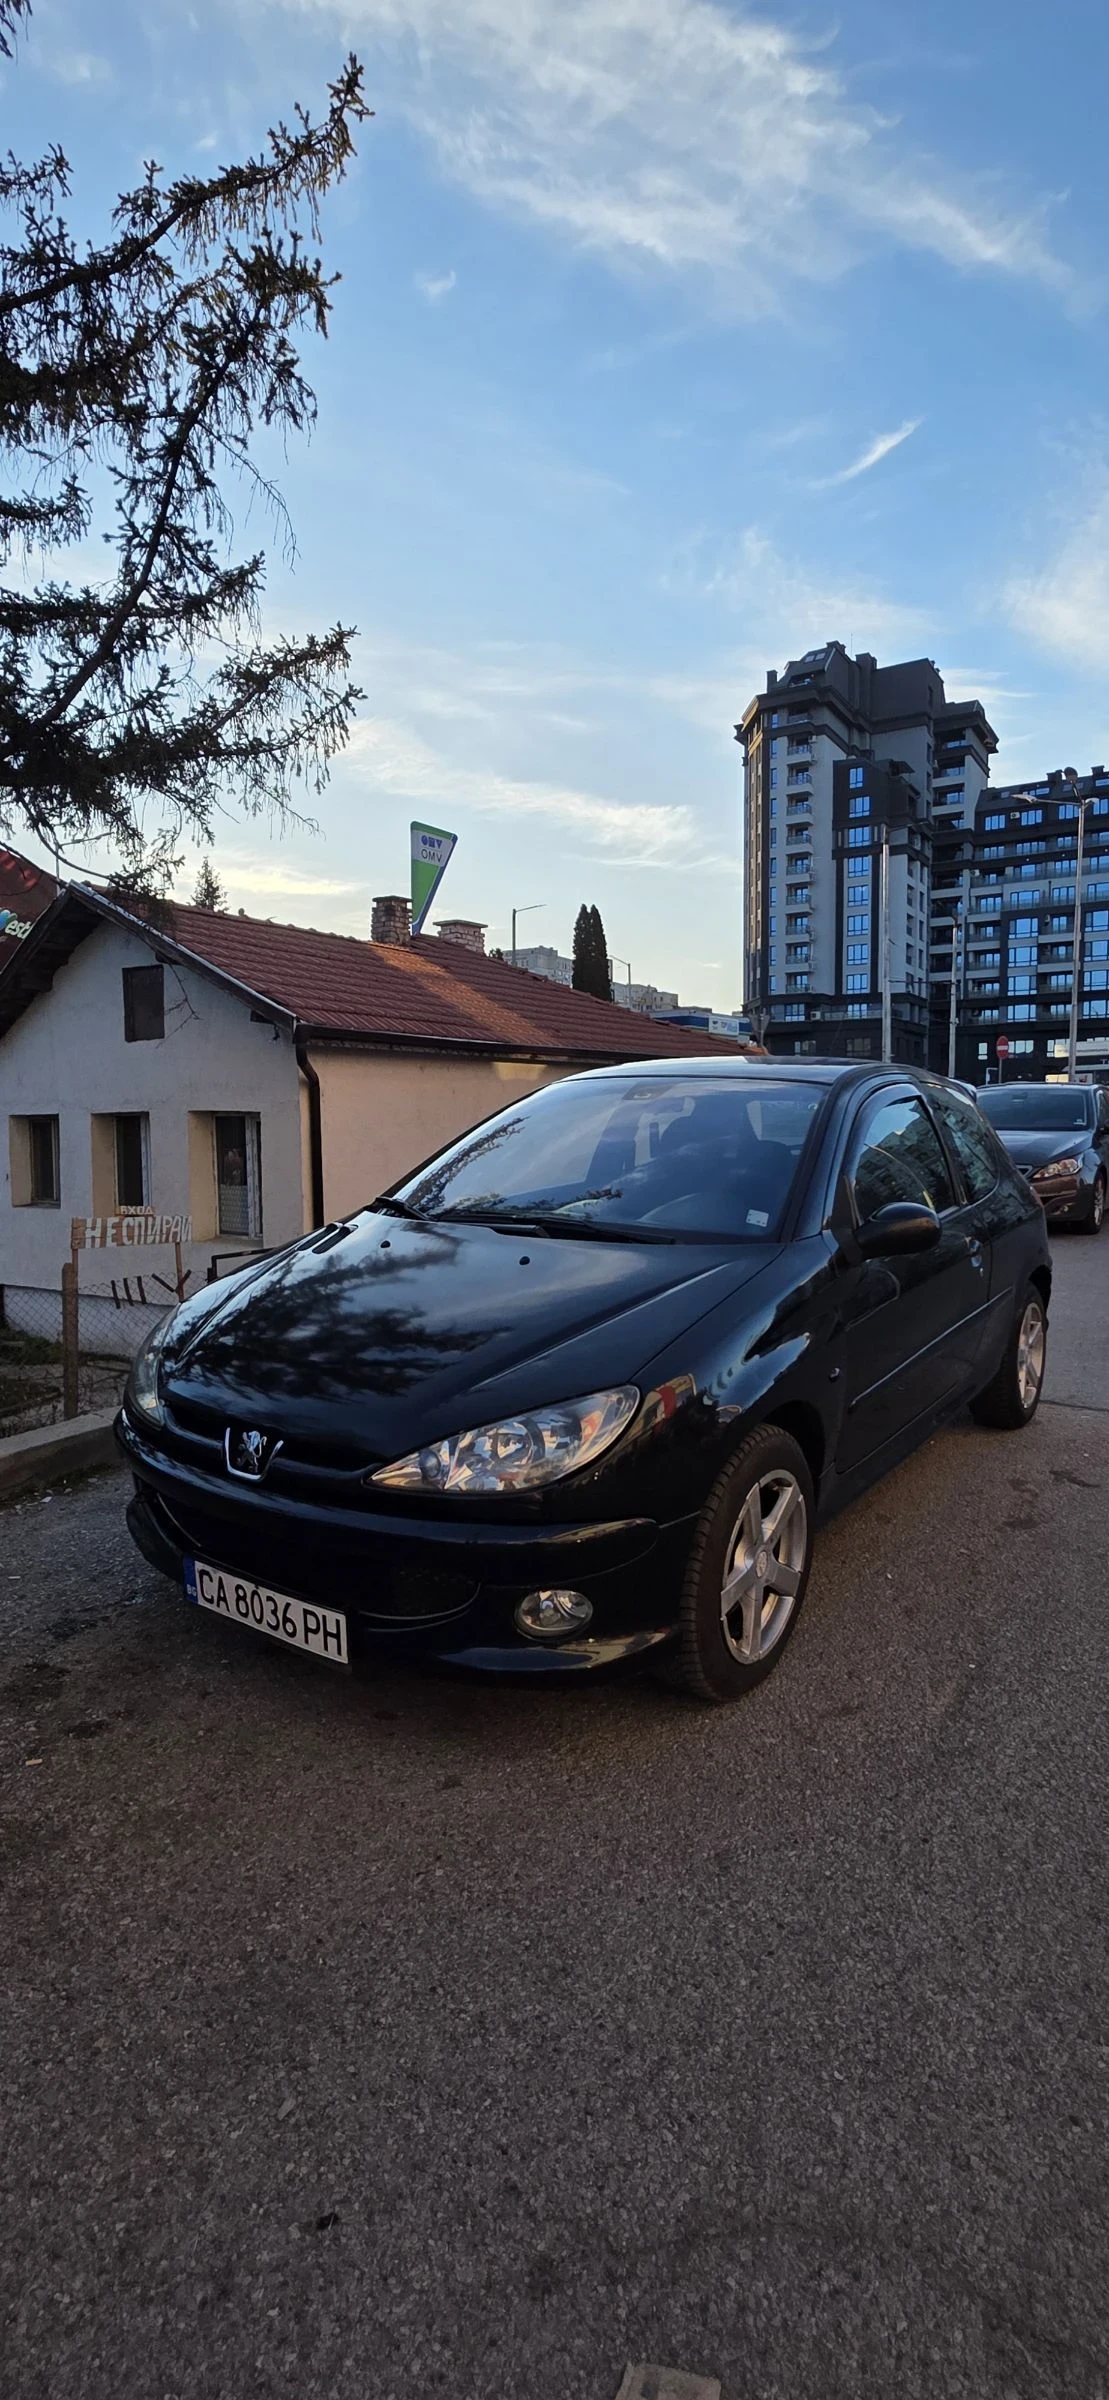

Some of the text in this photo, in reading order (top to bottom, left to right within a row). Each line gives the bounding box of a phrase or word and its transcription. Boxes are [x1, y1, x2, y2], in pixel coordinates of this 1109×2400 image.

[421, 848, 443, 863] OMV
[120, 1205, 154, 1216] ВХОД
[186, 1584, 198, 1597] BG
[198, 1568, 343, 1657] CA 8036 PH
